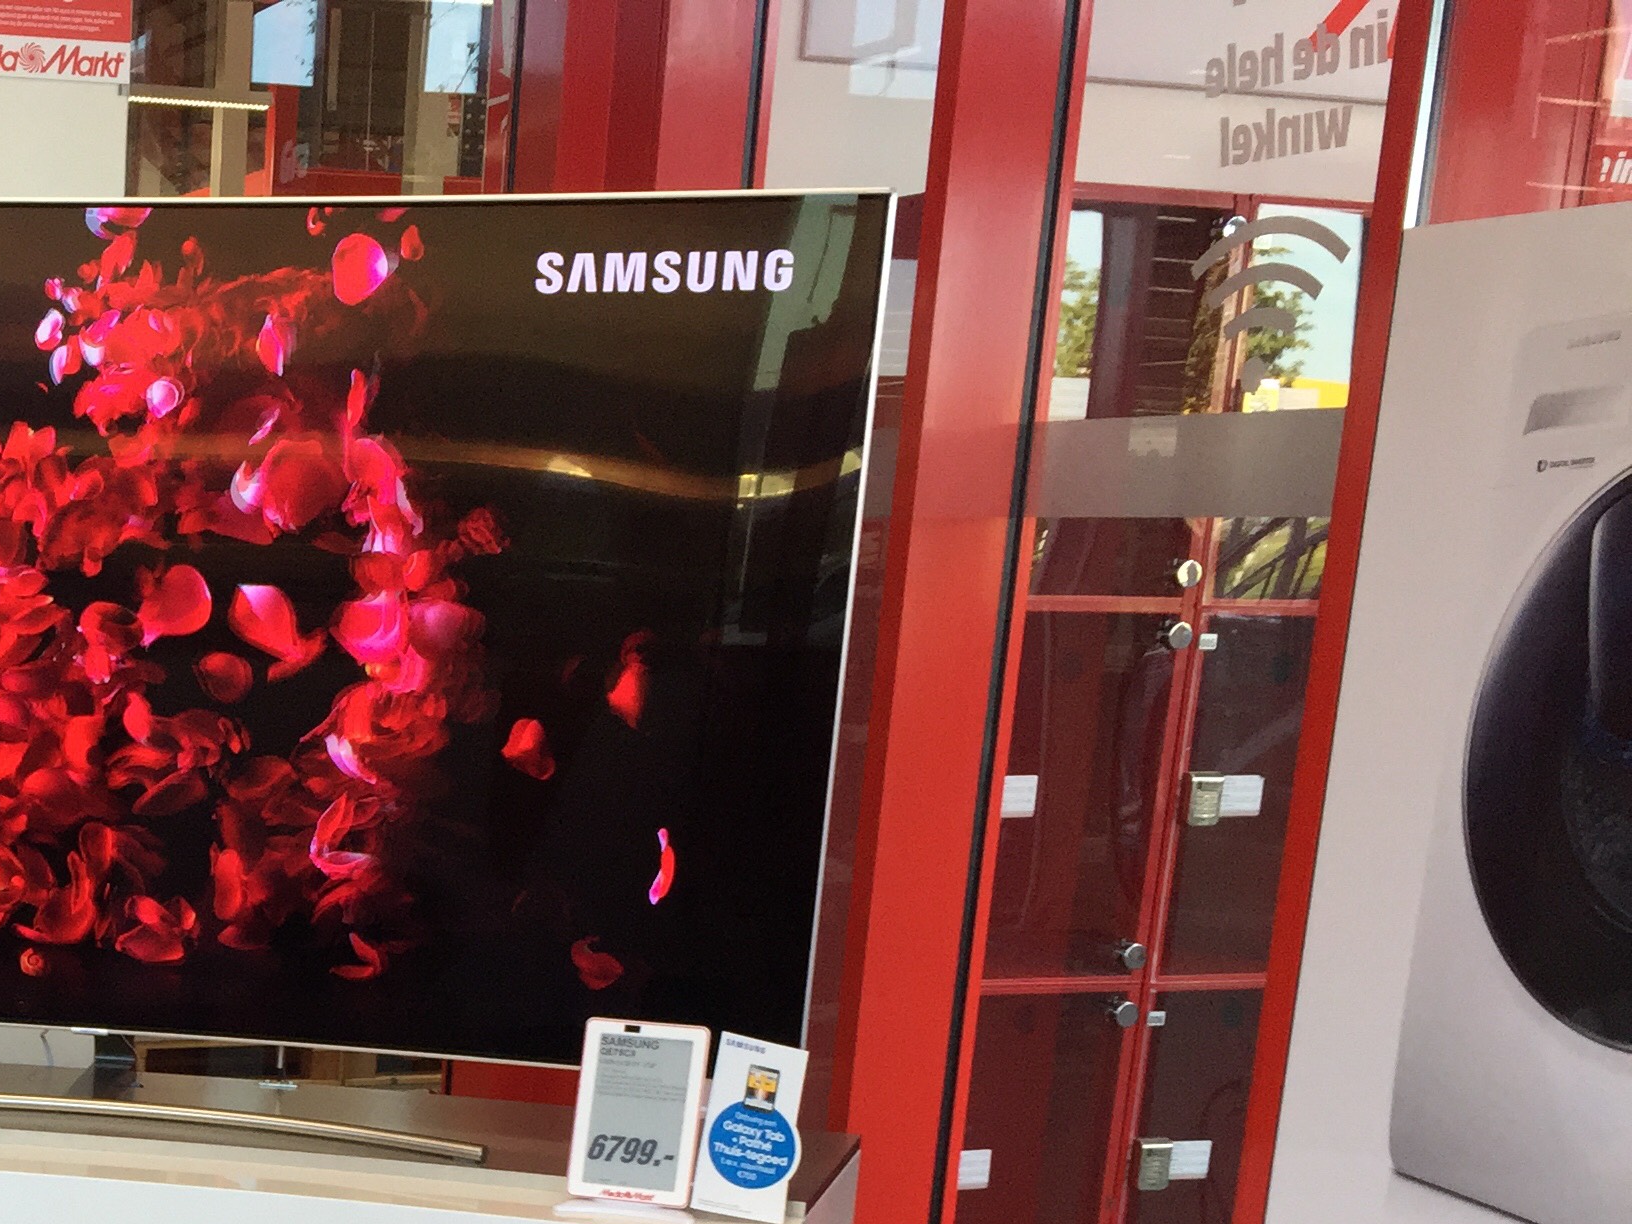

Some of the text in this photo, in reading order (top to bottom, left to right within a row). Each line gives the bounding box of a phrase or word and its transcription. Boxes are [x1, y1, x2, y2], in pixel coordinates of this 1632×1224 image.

[40, 44, 125, 78] Markt
[534, 248, 795, 295] SAMSUNG
[600, 1036, 660, 1050] SAMSUNG
[722, 1120, 786, 1143] Galaxy Tab
[586, 1133, 675, 1167] 6799.-
